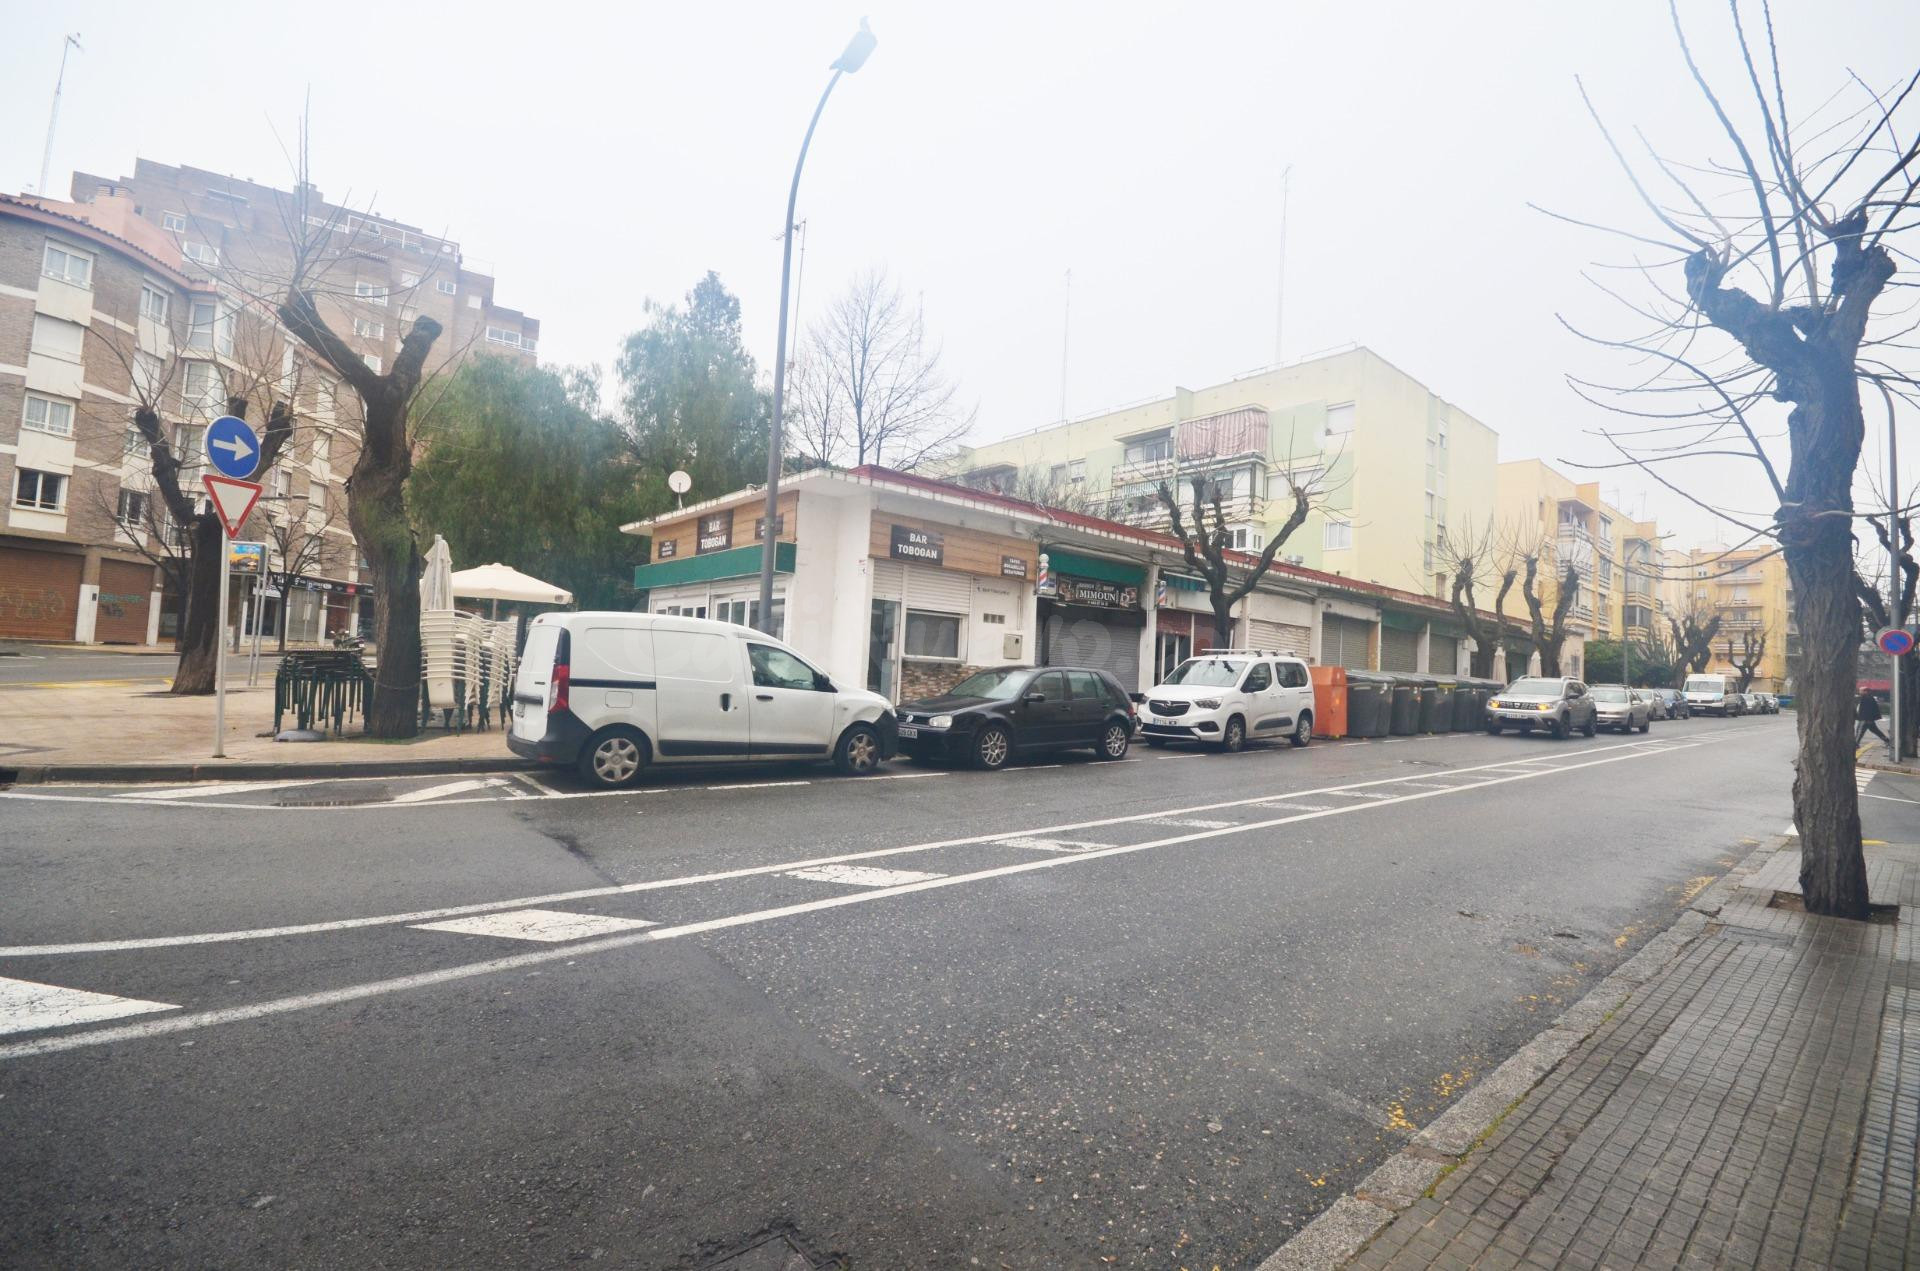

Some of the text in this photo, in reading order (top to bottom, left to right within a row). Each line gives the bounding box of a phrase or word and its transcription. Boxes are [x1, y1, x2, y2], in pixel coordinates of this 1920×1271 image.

[708, 520, 720, 533] BAR
[701, 534, 727, 549] TOBOGAN
[910, 533, 927, 544] BAR
[897, 543, 937, 559] TOBOGAN
[1079, 589, 1116, 601] MIMOUN
